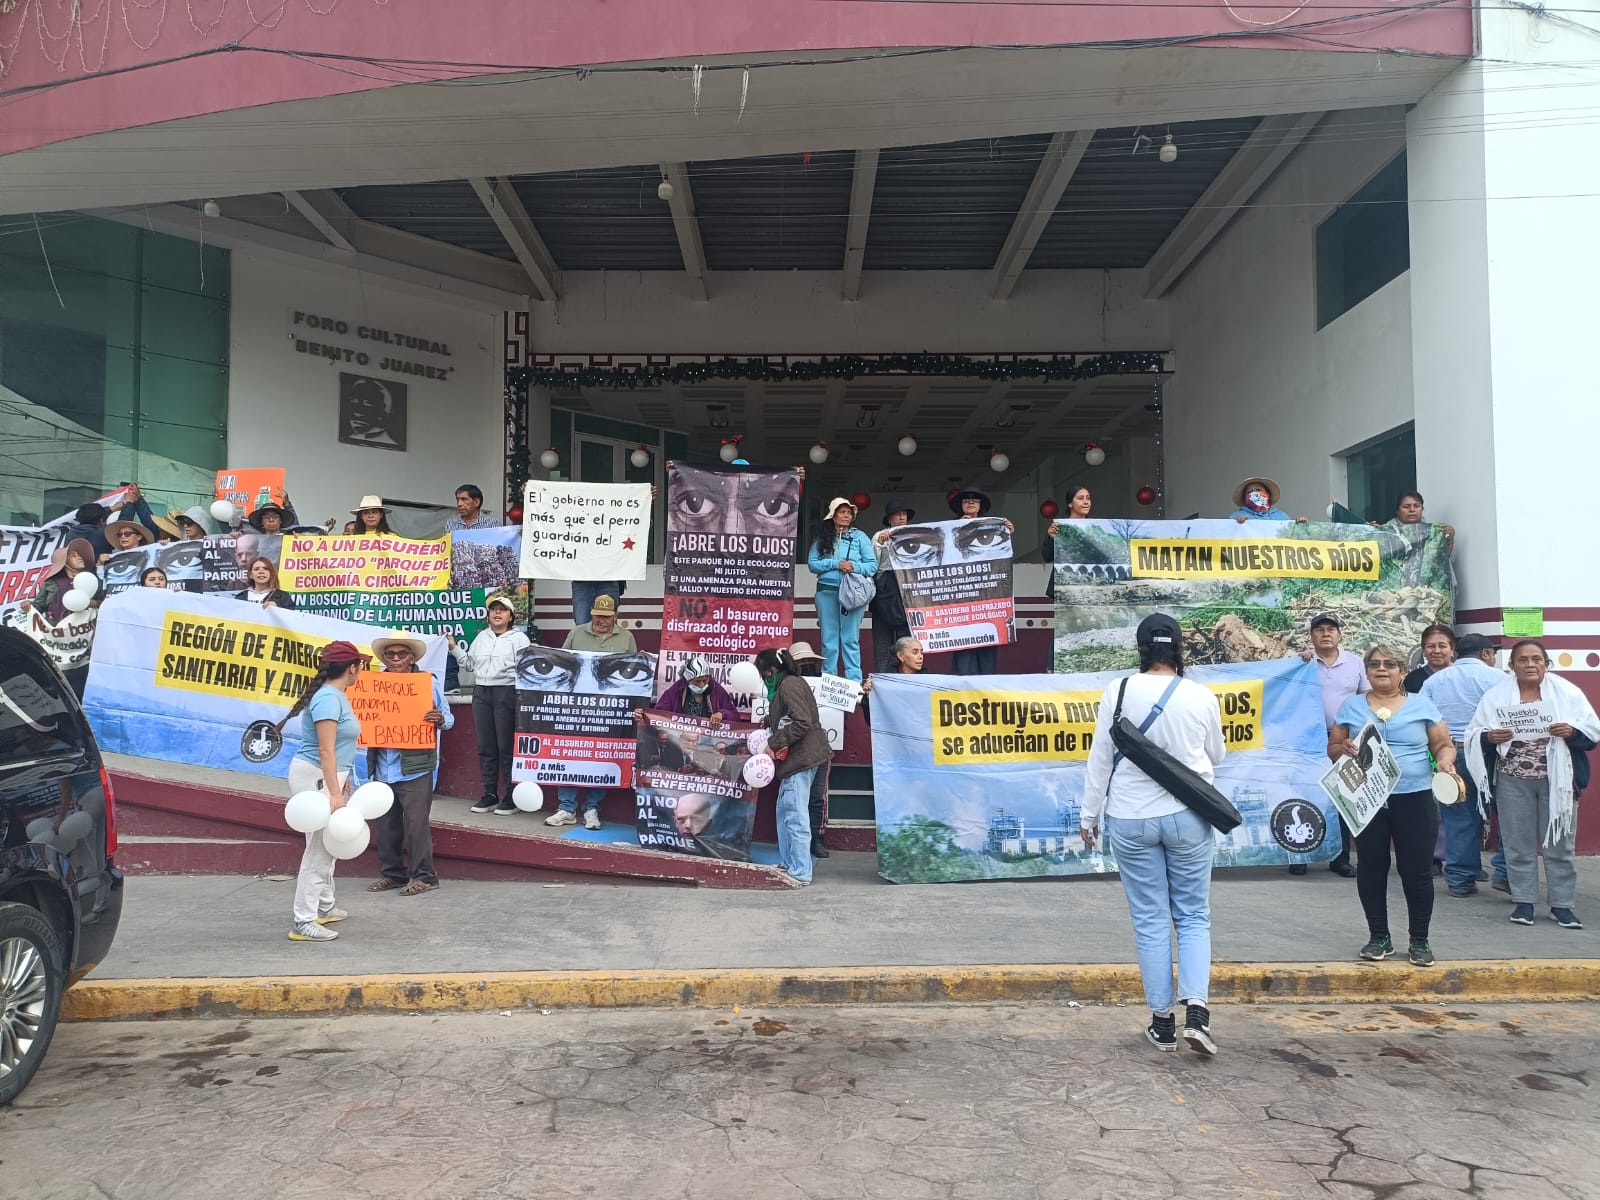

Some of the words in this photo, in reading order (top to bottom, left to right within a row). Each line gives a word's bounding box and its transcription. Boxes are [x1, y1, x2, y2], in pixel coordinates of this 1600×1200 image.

[294, 312, 348, 334] FORO
[358, 326, 451, 356] CULTURAL
[529, 492, 542, 502] El
[552, 494, 604, 509] gobierno
[610, 500, 622, 508] no
[626, 499, 640, 508] es
[530, 512, 556, 523] más
[564, 516, 586, 529] que
[593, 514, 604, 525] el
[609, 517, 640, 530] perro
[204, 540, 216, 548] DI
[220, 539, 237, 548] NO
[533, 530, 589, 544] guardián
[596, 533, 612, 546] del
[673, 534, 716, 552] ¡ABRE
[720, 536, 748, 552] LOS
[752, 537, 794, 556] OJOS!
[204, 550, 221, 560] AL
[292, 540, 314, 553] NO
[316, 540, 328, 552] A
[332, 539, 356, 552] UN
[358, 539, 446, 556] BASURERO
[284, 557, 366, 570] DISFRAZADO
[432, 557, 449, 572] DE
[692, 558, 722, 566] PARQUE
[747, 558, 790, 568] ECOLÓGICO
[1138, 546, 1213, 571] MATAN
[1220, 545, 1324, 571] NUESTROS
[1328, 543, 1374, 572] RÍOS
[204, 570, 248, 581] PARQUE
[918, 568, 944, 580] ¡ABRE
[947, 566, 964, 576] LOS
[966, 563, 992, 574] OJOS!
[295, 572, 360, 588] ECONOMÍA
[698, 577, 734, 585] AMENAZA
[758, 580, 792, 588] NUESTRA
[711, 586, 744, 594] NUESTRO
[310, 592, 356, 606] BOSQUE
[359, 592, 435, 606] PROTEGIDO
[438, 591, 472, 606] QUE
[353, 609, 374, 622] DE
[378, 609, 392, 622] LA
[395, 606, 487, 622] HUMANIDAD
[680, 598, 708, 618] NO
[713, 608, 724, 620] al
[728, 608, 779, 622] basurero
[908, 610, 926, 628] NO
[971, 601, 1012, 612] DISFRAZADO
[944, 615, 970, 624] PARQUE
[667, 619, 728, 634] disfrazado
[731, 622, 746, 634] de
[749, 624, 788, 638] parque
[917, 632, 928, 640] NO
[936, 632, 950, 640] MÁS
[169, 621, 238, 655] REGIÓN
[241, 632, 268, 660] DE
[699, 634, 756, 650] ecológico
[928, 634, 996, 650] CONTAMINACIÓN
[666, 652, 676, 661] EL
[704, 653, 750, 664] DICIEMBRE
[162, 653, 258, 692] SANITARIA
[264, 668, 277, 694] Y
[666, 665, 676, 682] DI
[355, 680, 368, 692] AL
[374, 680, 418, 696] PARQUE
[543, 694, 574, 706] ¡ABRE
[577, 696, 597, 706] LOS
[599, 698, 630, 708] OJOS!
[536, 706, 560, 714] PARQUE
[582, 708, 615, 716] ECOLÓGICO
[939, 698, 1060, 728] Destruyen
[1508, 708, 1538, 718] pueblo
[556, 716, 586, 724] AMENAZA
[606, 718, 632, 726] NUESTRA
[650, 720, 702, 734] ECONOMÍA
[672, 716, 698, 726] PARA
[518, 736, 540, 755] NO
[554, 739, 594, 748] BASURERO
[942, 736, 964, 756] se
[970, 729, 1048, 755] adueñan
[1054, 730, 1076, 752] de
[562, 749, 592, 758] PARQUE
[595, 750, 636, 759] ECOLÓGICO
[524, 760, 538, 770] NO
[548, 763, 566, 771] MÁS
[537, 772, 616, 784] CONTAMINACIÓN
[640, 770, 662, 778] PARA
[666, 773, 712, 784] NUESTRAS
[714, 778, 752, 792] FAMILIAS
[652, 778, 743, 799] ENFERMEDAD
[637, 794, 650, 806] DI
[654, 796, 678, 808] NO
[638, 808, 658, 820] AL
[638, 834, 696, 849] PARQUE
